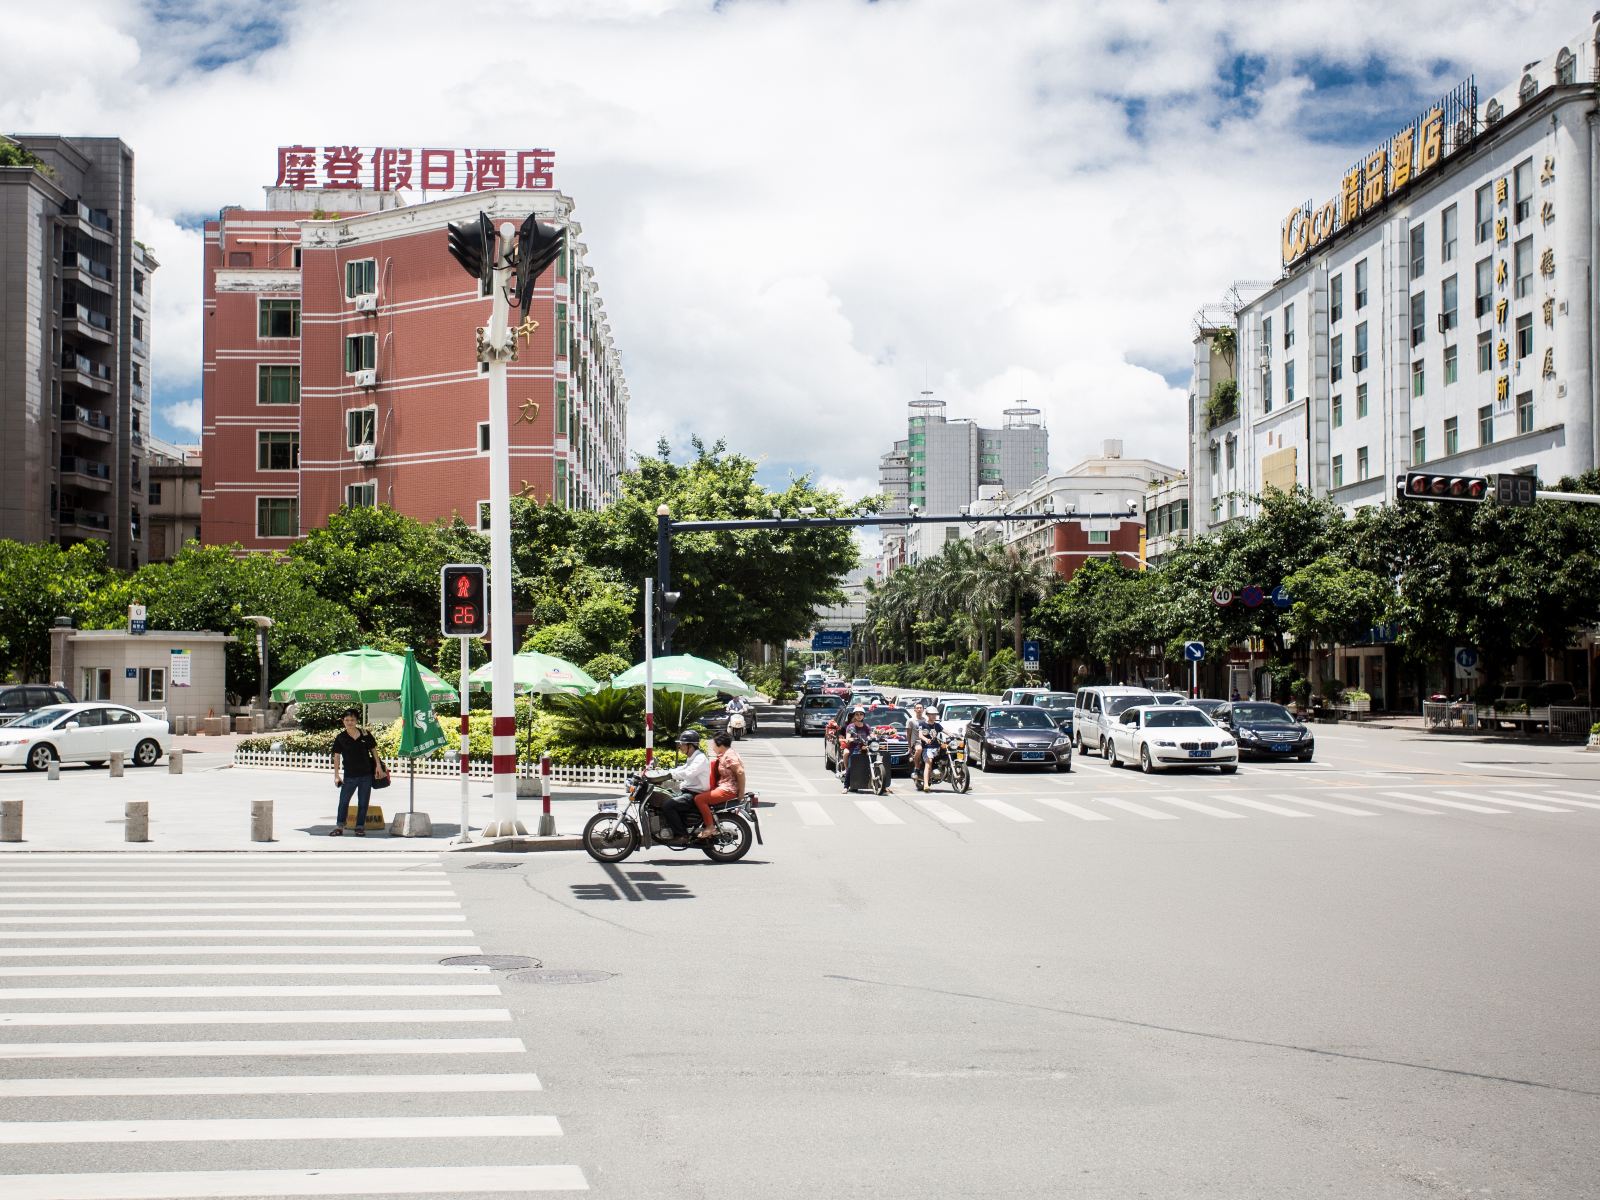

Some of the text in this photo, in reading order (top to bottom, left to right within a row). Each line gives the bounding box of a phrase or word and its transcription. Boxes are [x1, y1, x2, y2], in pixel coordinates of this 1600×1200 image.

[276, 144, 555, 192] 摩登假日酒店
[1283, 107, 1444, 262] Coco 精品酒店
[1496, 177, 1509, 402] 贵妃水疗会所
[454, 606, 474, 624] 26
[1216, 590, 1230, 601] 40
